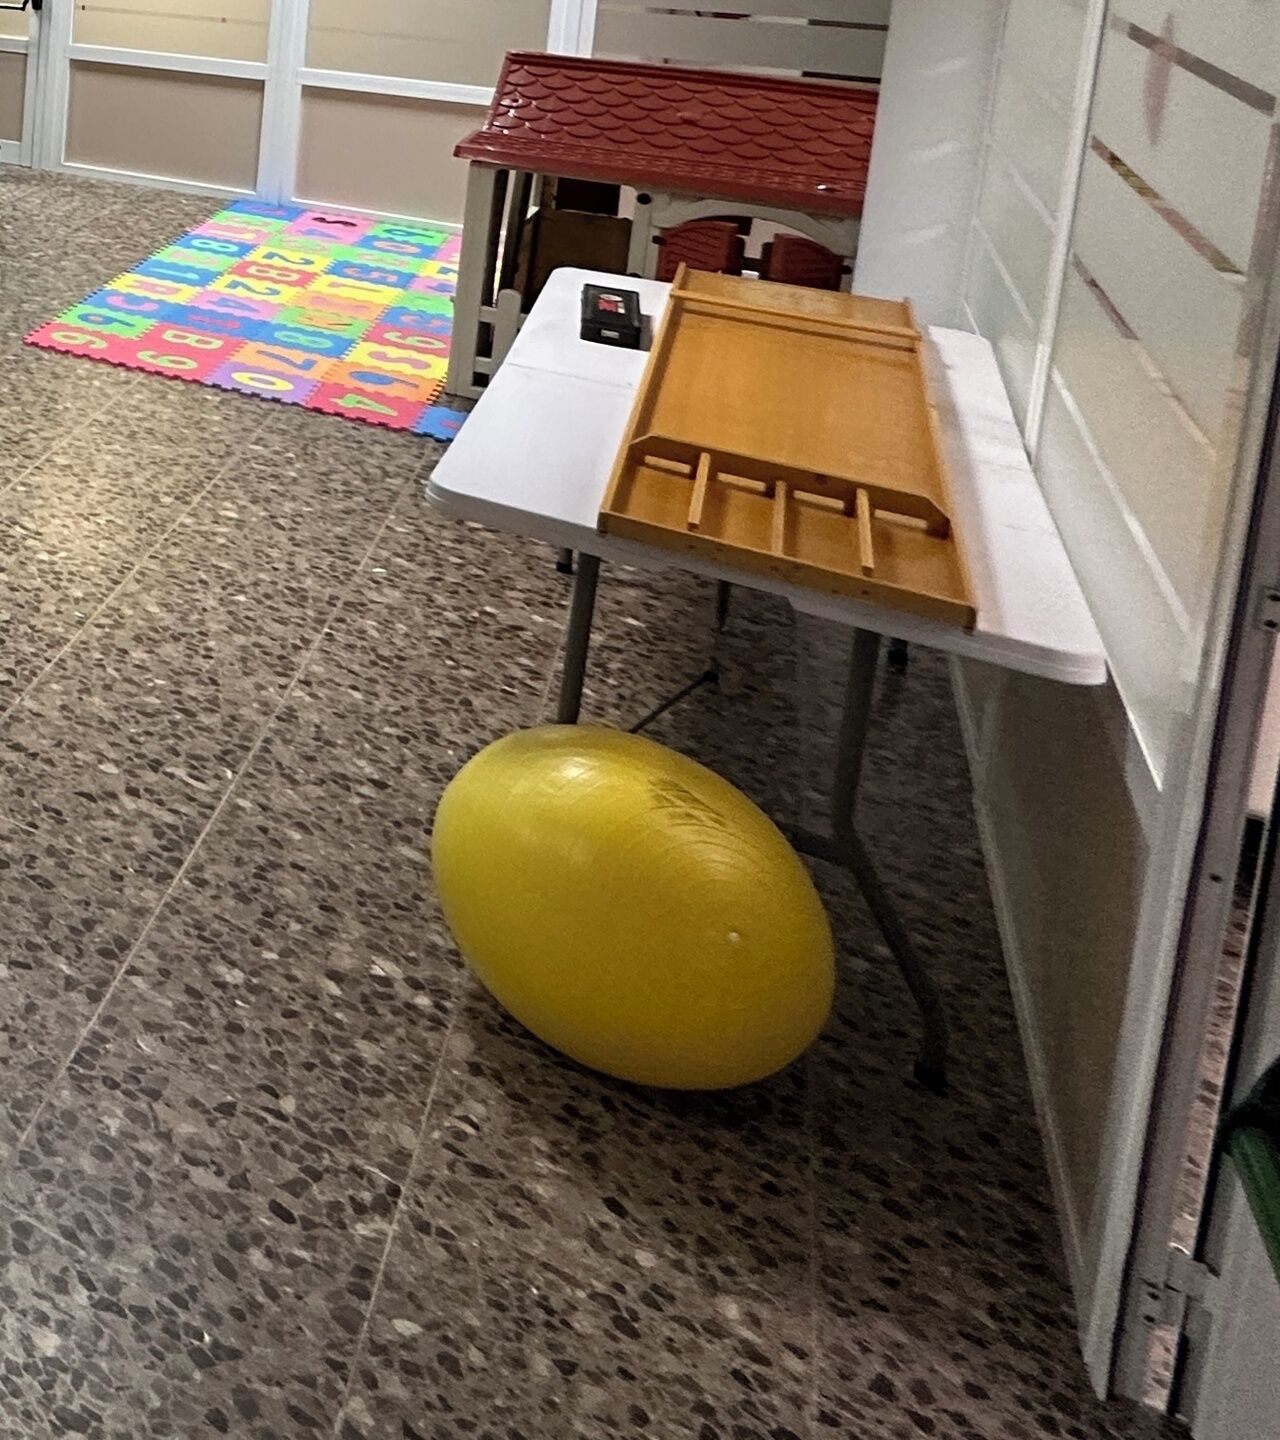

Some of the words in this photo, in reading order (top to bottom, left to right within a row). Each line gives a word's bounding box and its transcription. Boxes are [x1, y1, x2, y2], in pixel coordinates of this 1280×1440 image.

[191, 239, 240, 252] 8
[262, 251, 315, 265] 2
[224, 279, 281, 296] 2
[162, 329, 224, 350] B
[256, 349, 318, 371] 7
[328, 393, 399, 417] 4
